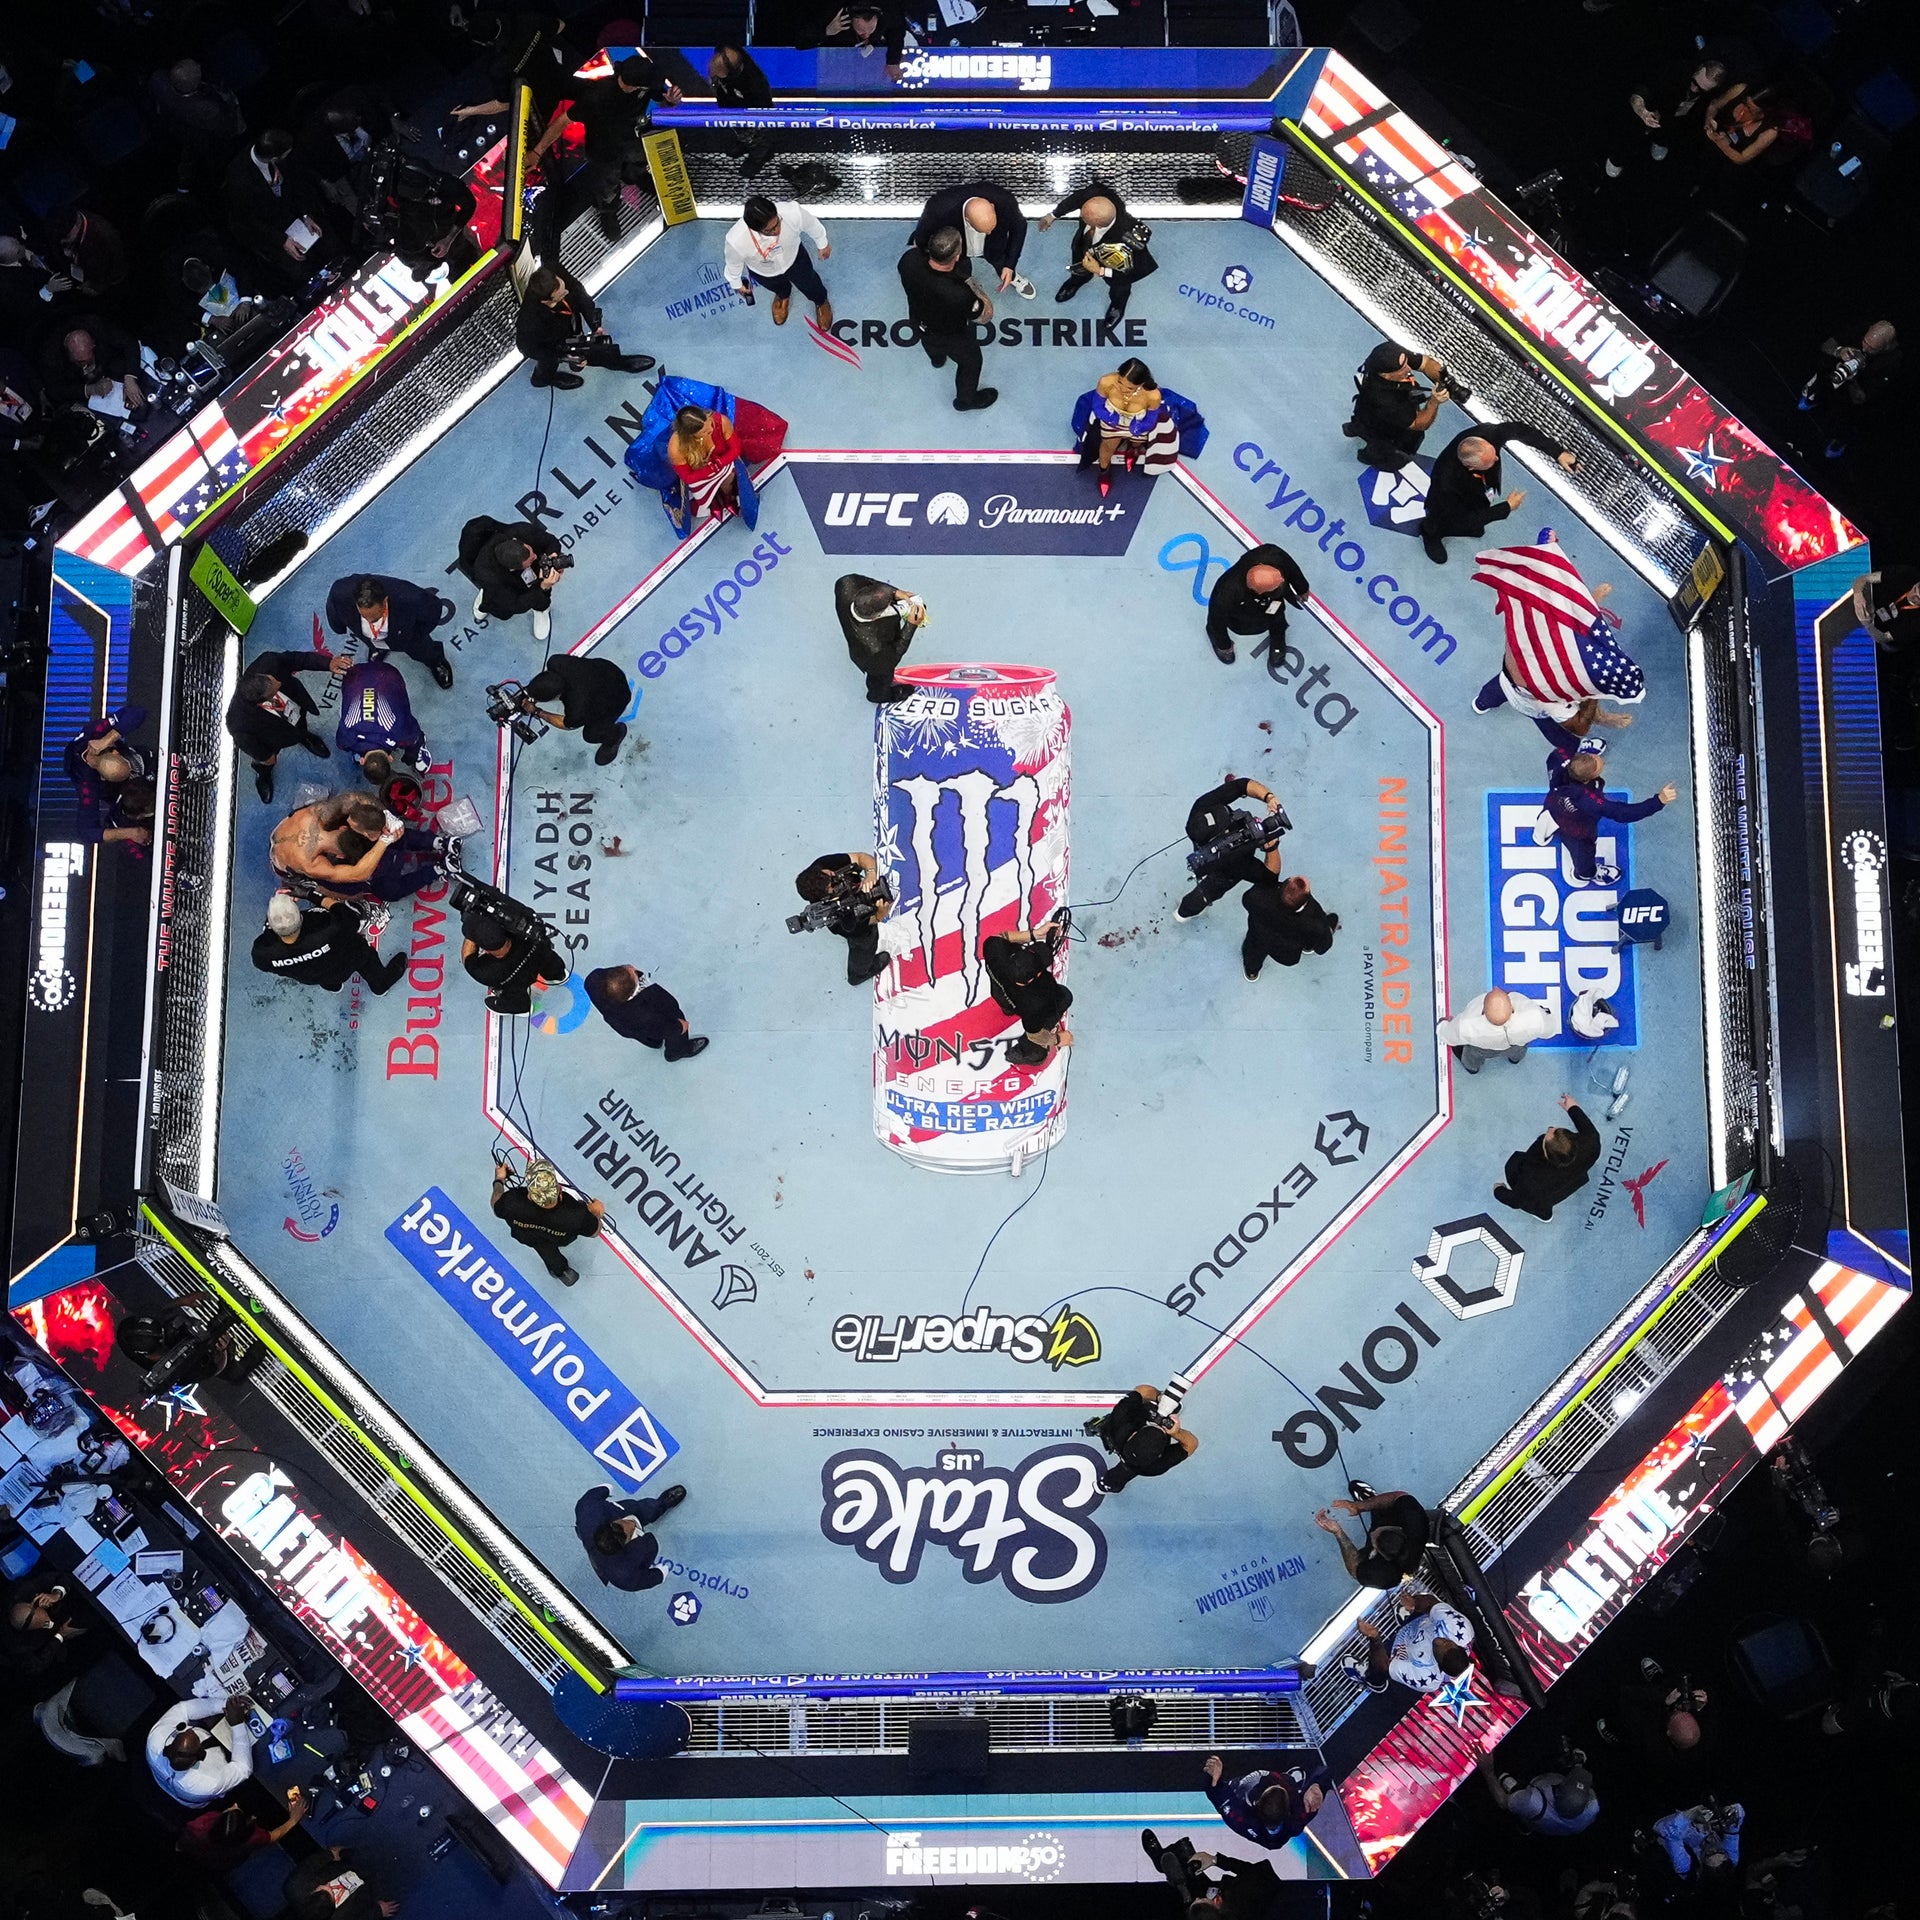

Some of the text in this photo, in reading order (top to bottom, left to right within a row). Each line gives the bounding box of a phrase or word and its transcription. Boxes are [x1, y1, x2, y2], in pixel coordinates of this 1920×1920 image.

[838, 117, 936, 129] Polymarket
[1122, 120, 1218, 132] Polymarket
[1343, 190, 1377, 222] RIYADH
[665, 299, 694, 320] NEW
[701, 298, 745, 319] VODKA
[1178, 281, 1276, 330] crypto.com
[1440, 280, 1476, 314] RIYADH
[833, 318, 1148, 348] CRODSTRIKE
[1539, 372, 1575, 406] RIYADH
[1639, 465, 1676, 500] RIYADH
[824, 492, 1126, 528] UFC Paramount+
[1233, 442, 1458, 666] crypto.com
[638, 530, 792, 678] easypost
[1250, 636, 1360, 737] eta
[972, 698, 1052, 717] SUGAR
[158, 753, 181, 970] THE WHITE HOUSE
[533, 791, 562, 950] IYADH
[565, 792, 601, 951] SEASON
[1733, 753, 1755, 970] THE WHITE HOUSE
[1372, 777, 1413, 1065] NINJATRADER
[1622, 906, 1664, 924] UFC
[272, 943, 331, 968] MONROE
[349, 975, 363, 1030] SINCE
[1363, 953, 1376, 1020] PAYWARD
[878, 1023, 1020, 1071] MONST
[1363, 1022, 1373, 1064] company
[887, 1089, 1053, 1118] ULTRA RED WHITE
[896, 1071, 1043, 1100] ENERGY
[902, 1111, 1035, 1132] & BLUE RAZZ
[289, 1145, 324, 1219] POINT USA
[598, 1088, 746, 1245] FIGHT UNFAIR
[281, 1158, 314, 1224] TURNING
[573, 1112, 721, 1269] ANDURIL
[1166, 1162, 1319, 1317] EXODUS
[750, 1241, 785, 1278] EST. 2017
[401, 1197, 611, 1422] Polymarket
[834, 1308, 1048, 1361] SuperFile
[1272, 1301, 1441, 1469] IONQ
[812, 1428, 880, 1438] EXPERIENCE
[883, 1428, 925, 1438] CASINO
[927, 1428, 988, 1438] IMMERSIVE
[991, 1428, 999, 1438] &
[1001, 1428, 1073, 1438] INTERACTIVE
[832, 1454, 1097, 1592] Stake
[1196, 1555, 1306, 1615] NEW AMSTERDAM
[1221, 1556, 1268, 1580] VODKA
